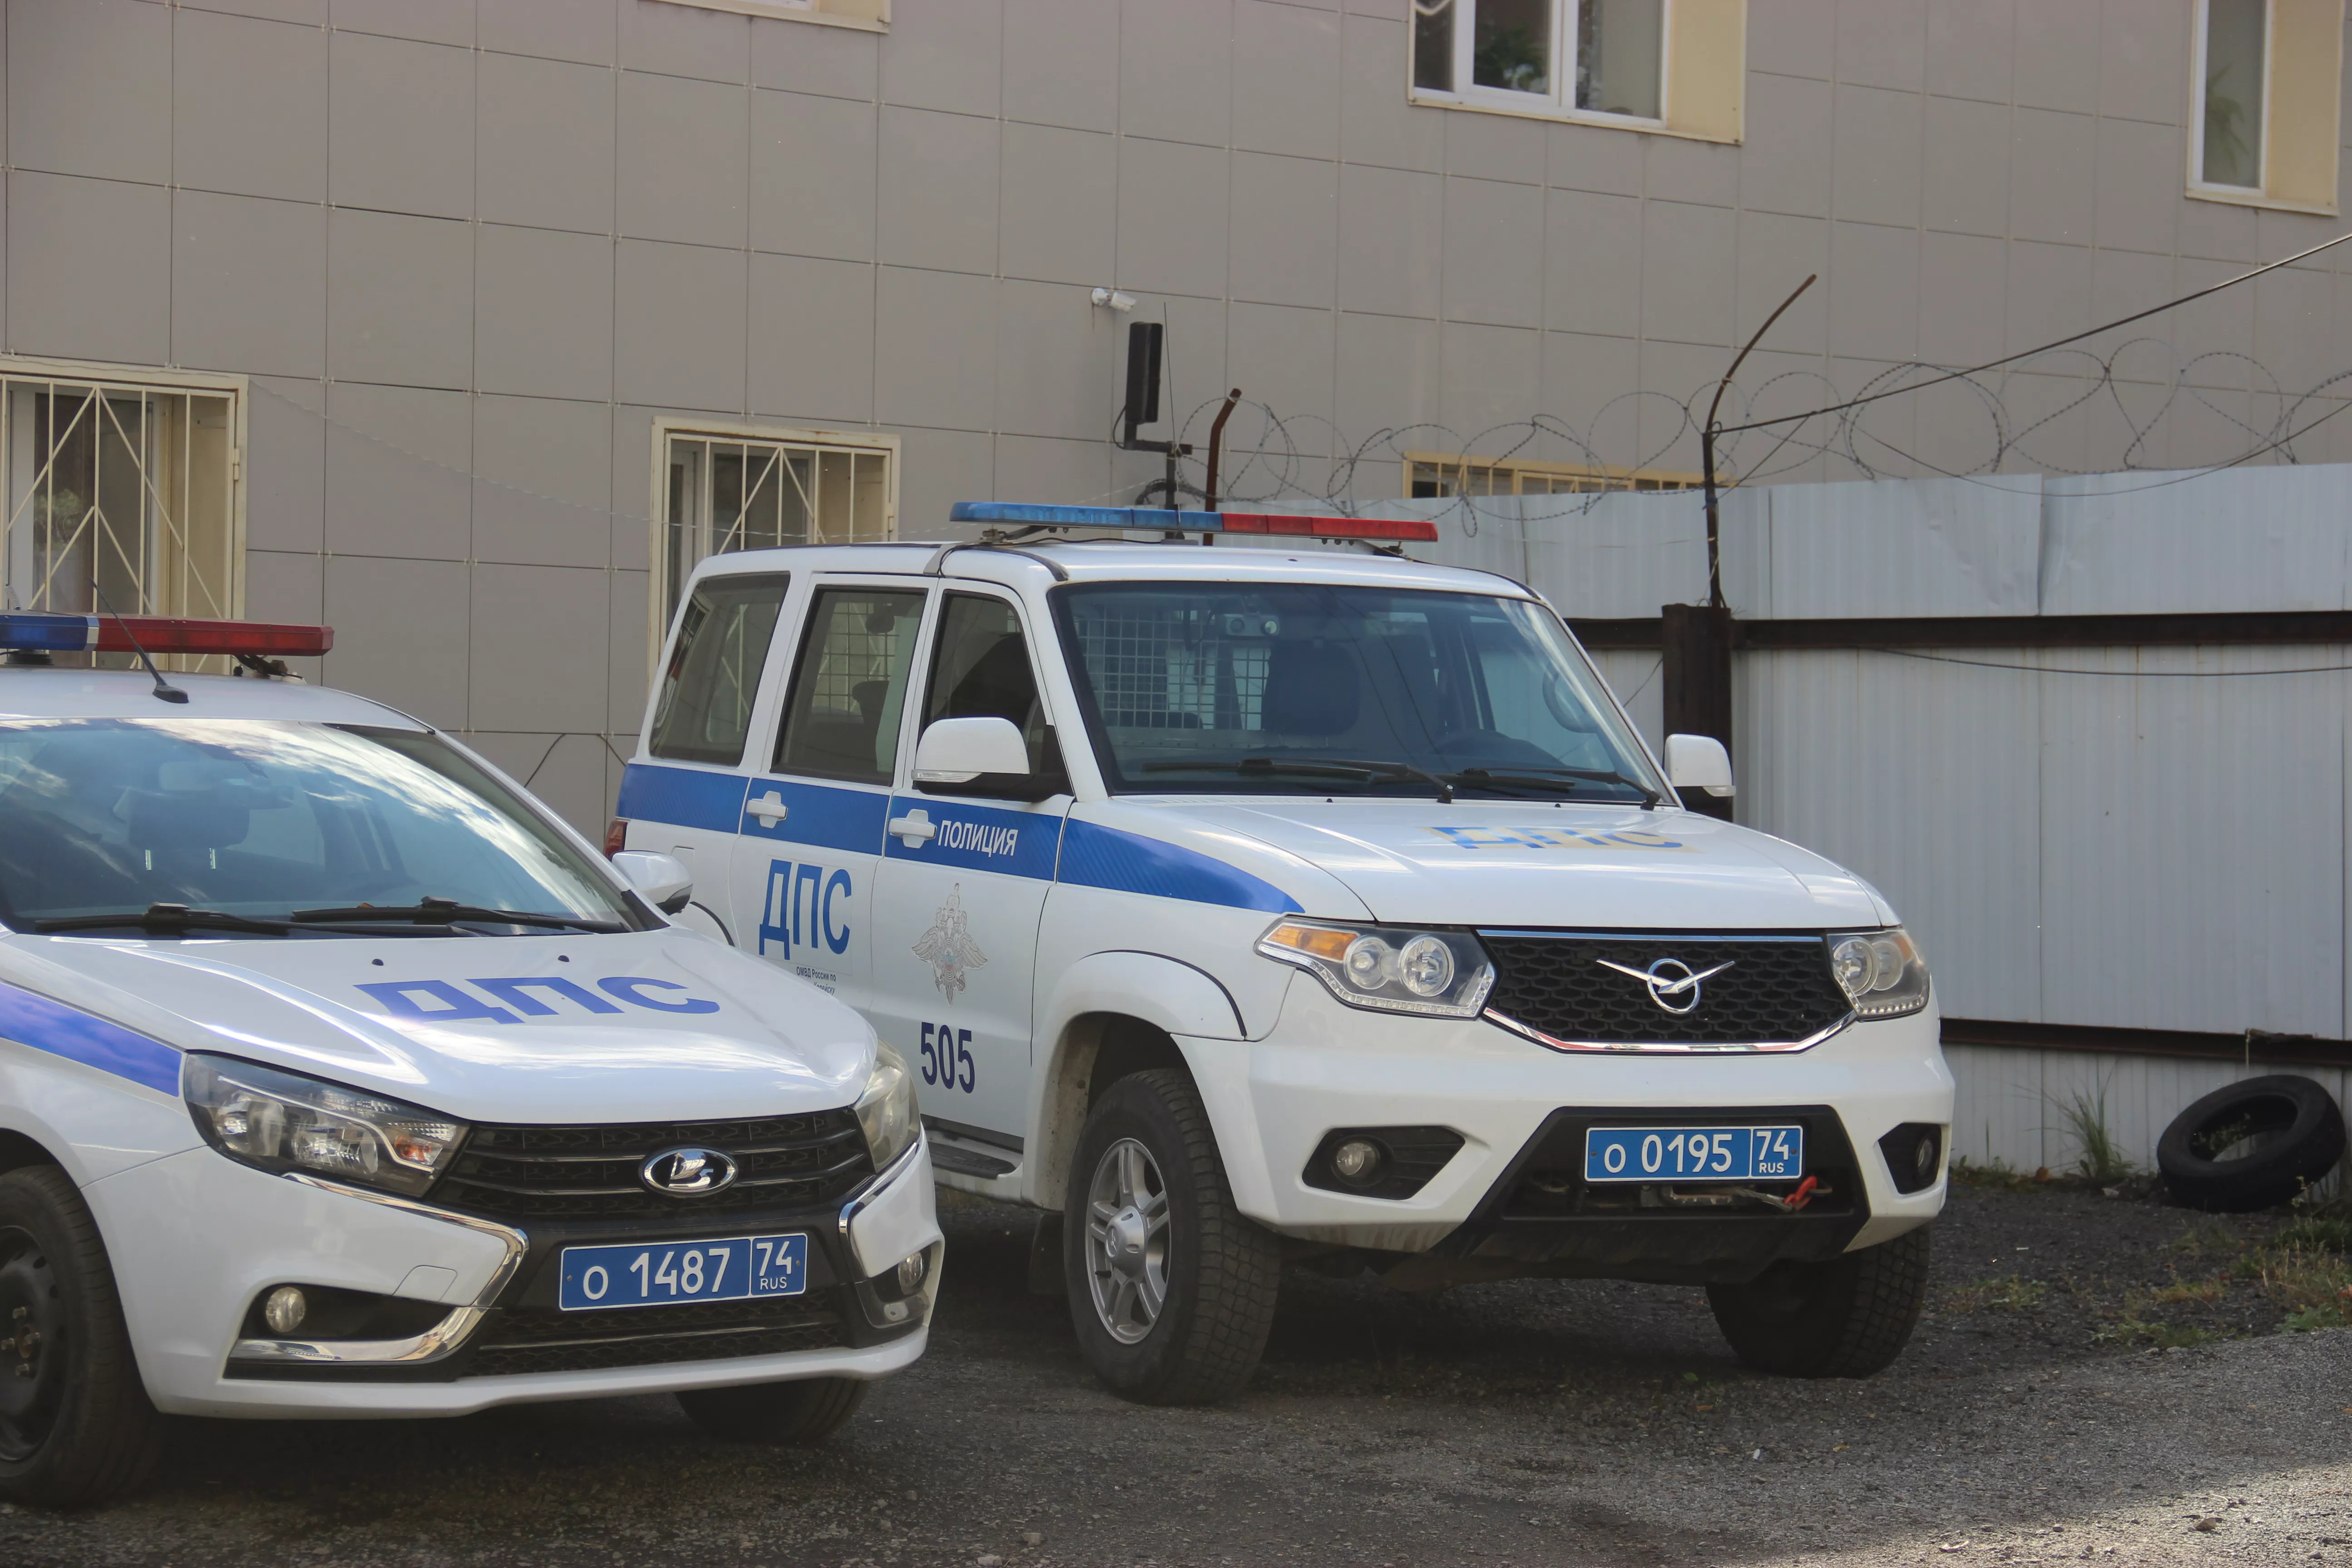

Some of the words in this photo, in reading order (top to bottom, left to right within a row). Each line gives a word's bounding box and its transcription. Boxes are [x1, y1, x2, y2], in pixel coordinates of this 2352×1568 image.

[938, 820, 1018, 858] ПОЛИЦИЯ
[1431, 826, 1684, 850] ДПС
[759, 859, 853, 961] ДПС
[796, 966, 811, 979] ОМВД
[812, 969, 829, 980] России
[352, 977, 720, 1031] ДПС
[921, 1021, 975, 1094] 505
[1641, 1134, 1732, 1173] 0195
[1756, 1131, 1789, 1161] 74
[1759, 1162, 1784, 1173] RUS
[630, 1247, 730, 1297] 1487
[756, 1241, 792, 1277] 74
[760, 1276, 788, 1290] RUS
